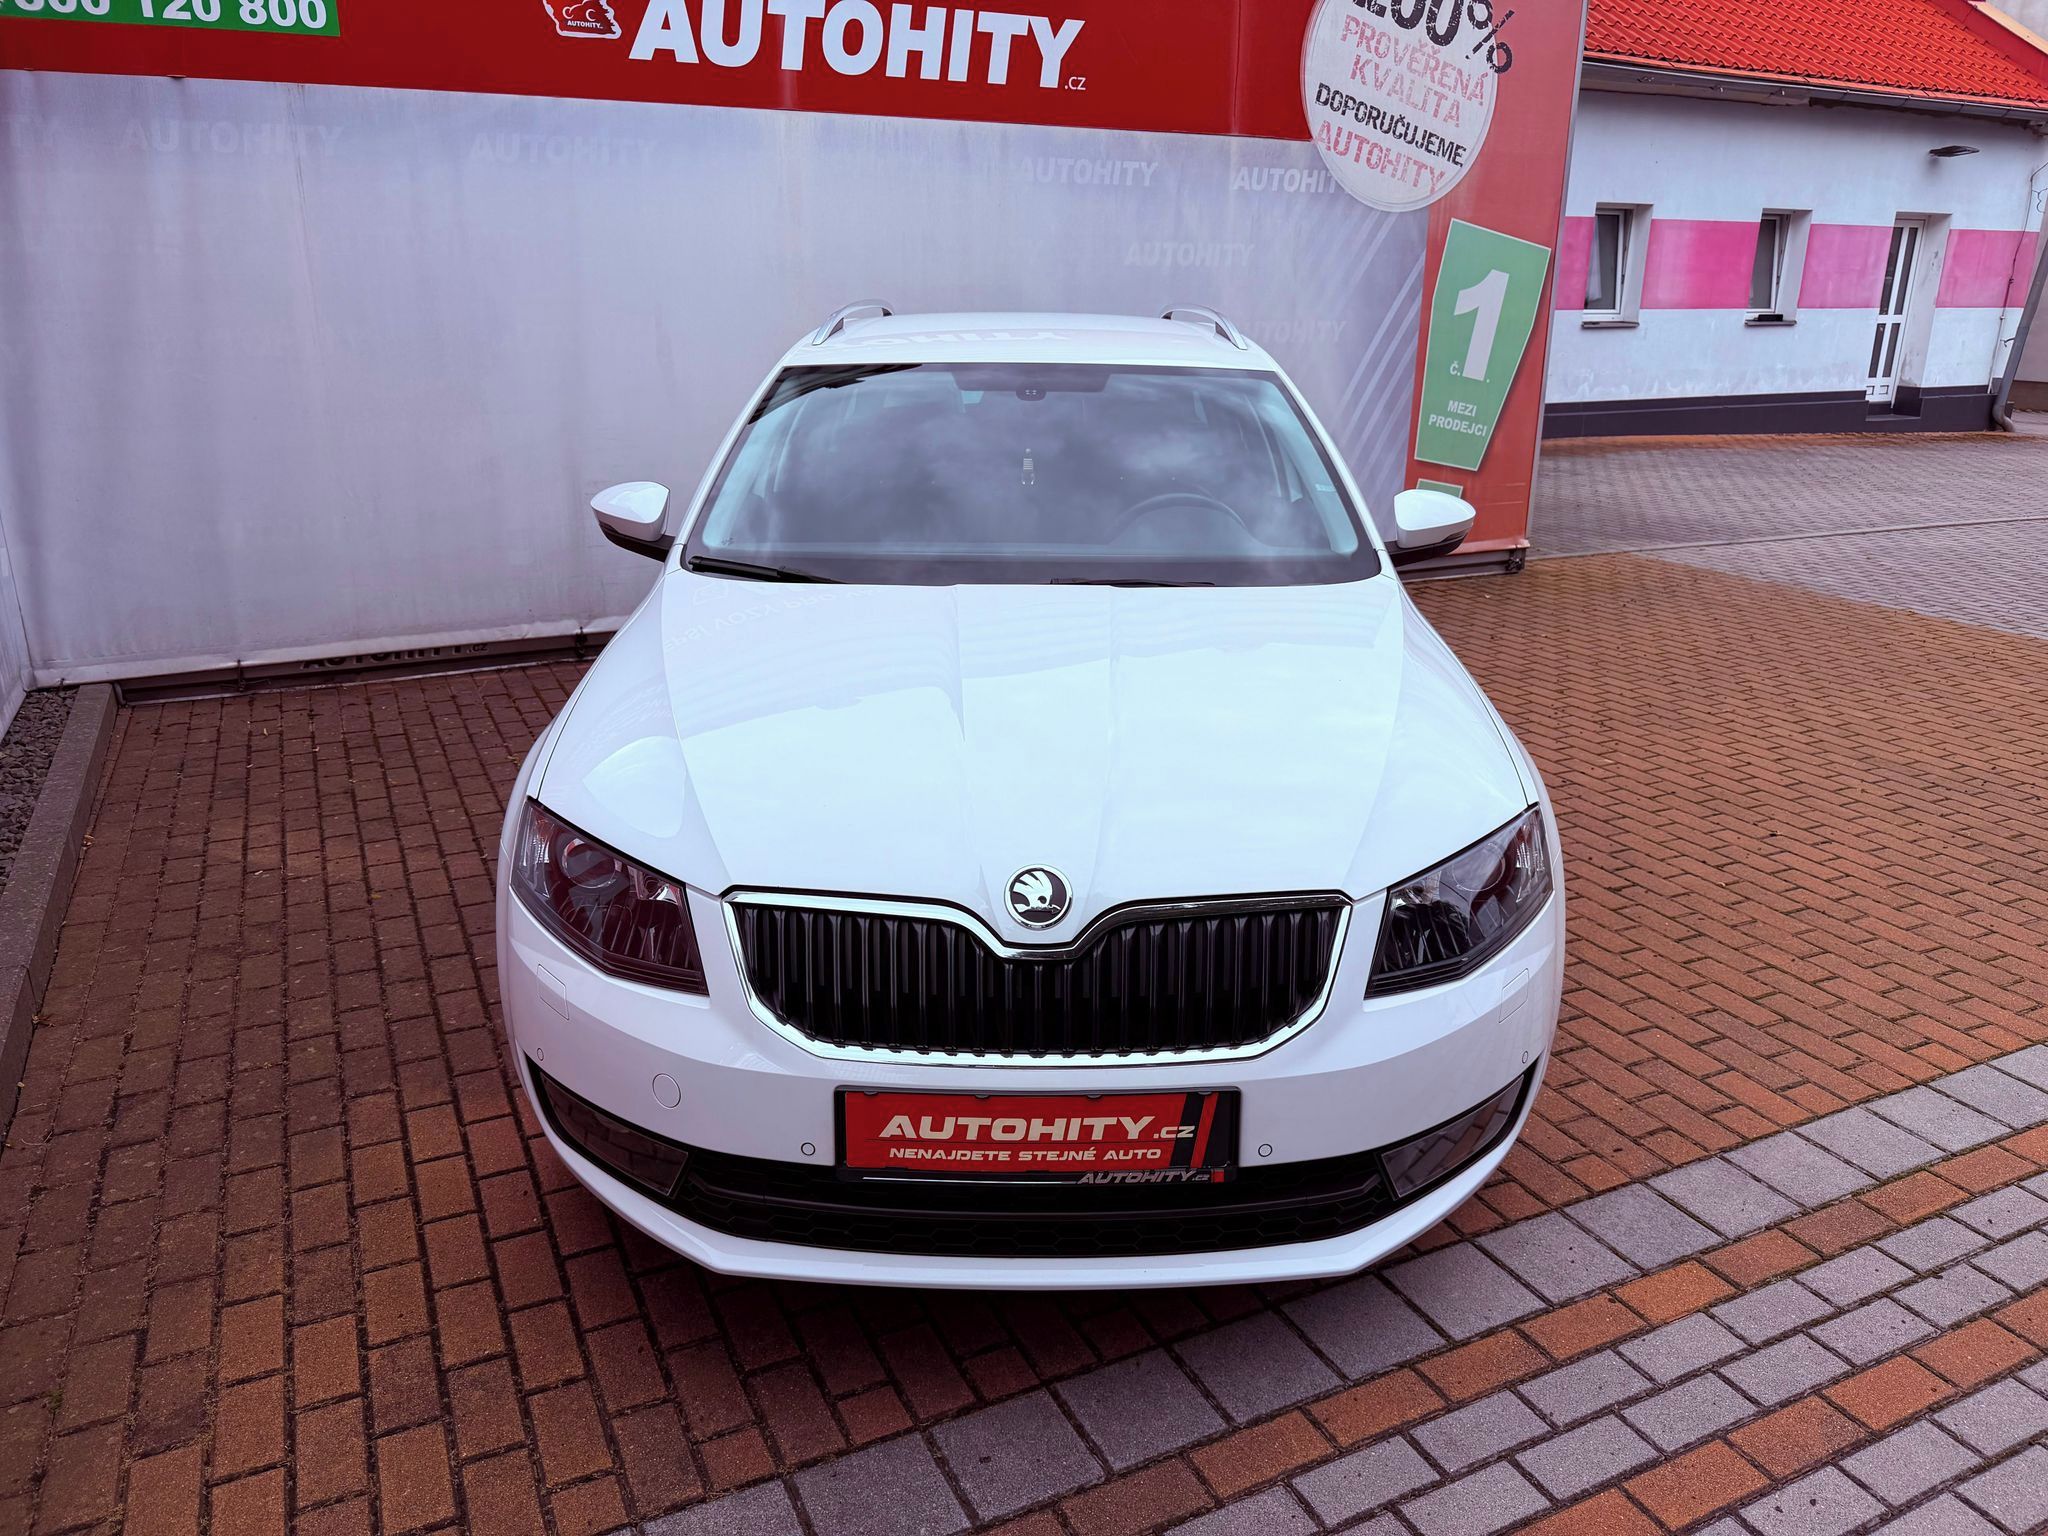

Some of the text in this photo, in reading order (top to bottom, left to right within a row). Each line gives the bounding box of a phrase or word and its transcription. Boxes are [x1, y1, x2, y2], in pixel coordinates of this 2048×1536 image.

[1350, 54, 1461, 128] KVALITA
[1314, 82, 1467, 168] DOPORUČUJEME
[1317, 120, 1446, 195] AUTOHITY
[1231, 166, 1345, 194] AUTOHIT
[1447, 400, 1477, 417] MEZI
[1428, 413, 1487, 437] PRODEJCI
[889, 1147, 1162, 1162] NENAJDETE STEJNÉ AUTO
